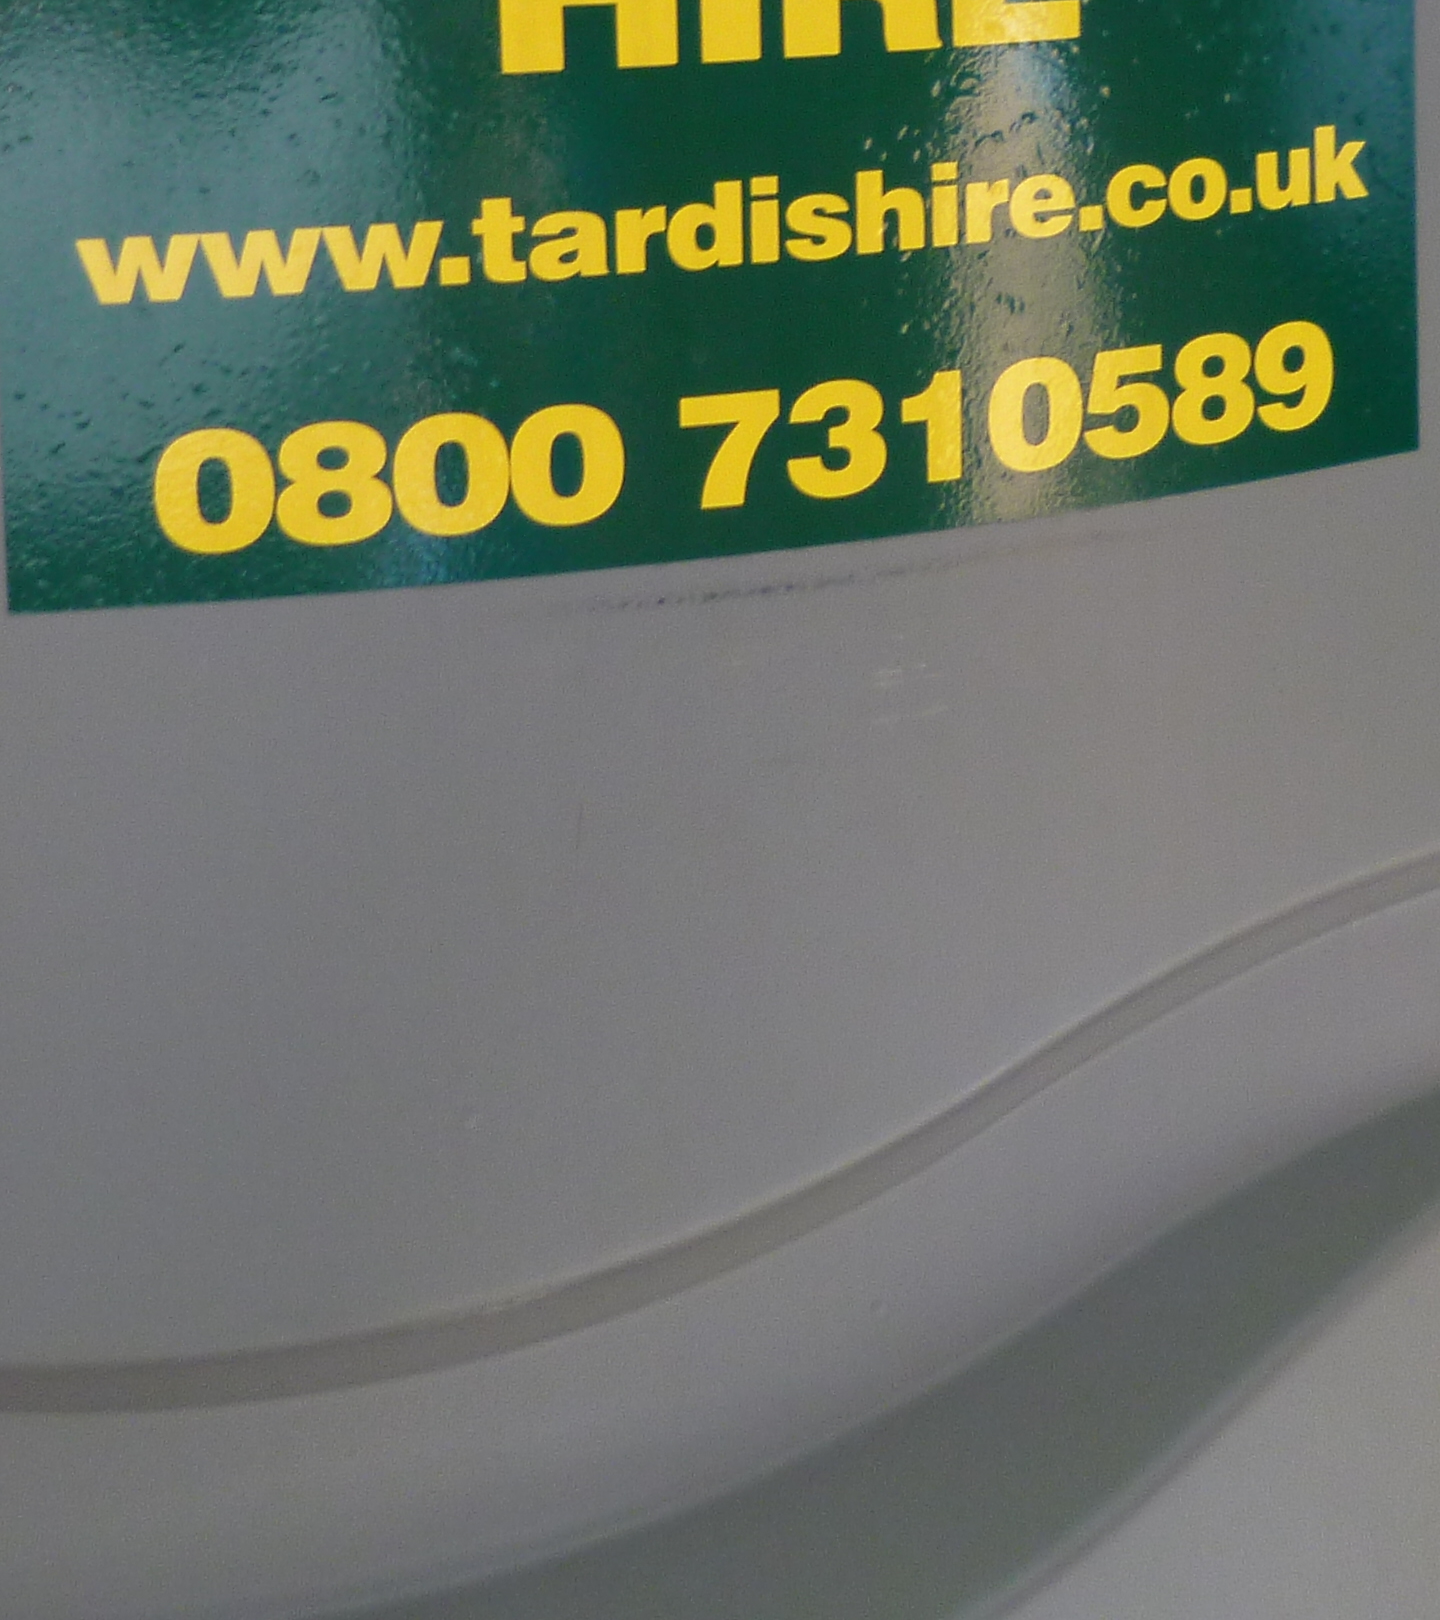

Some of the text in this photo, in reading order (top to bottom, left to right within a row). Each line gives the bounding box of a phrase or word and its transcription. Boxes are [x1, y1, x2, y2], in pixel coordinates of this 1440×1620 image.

[75, 124, 1370, 307] www.tardishire.co.uk
[152, 318, 1337, 556] 0800 7310589
